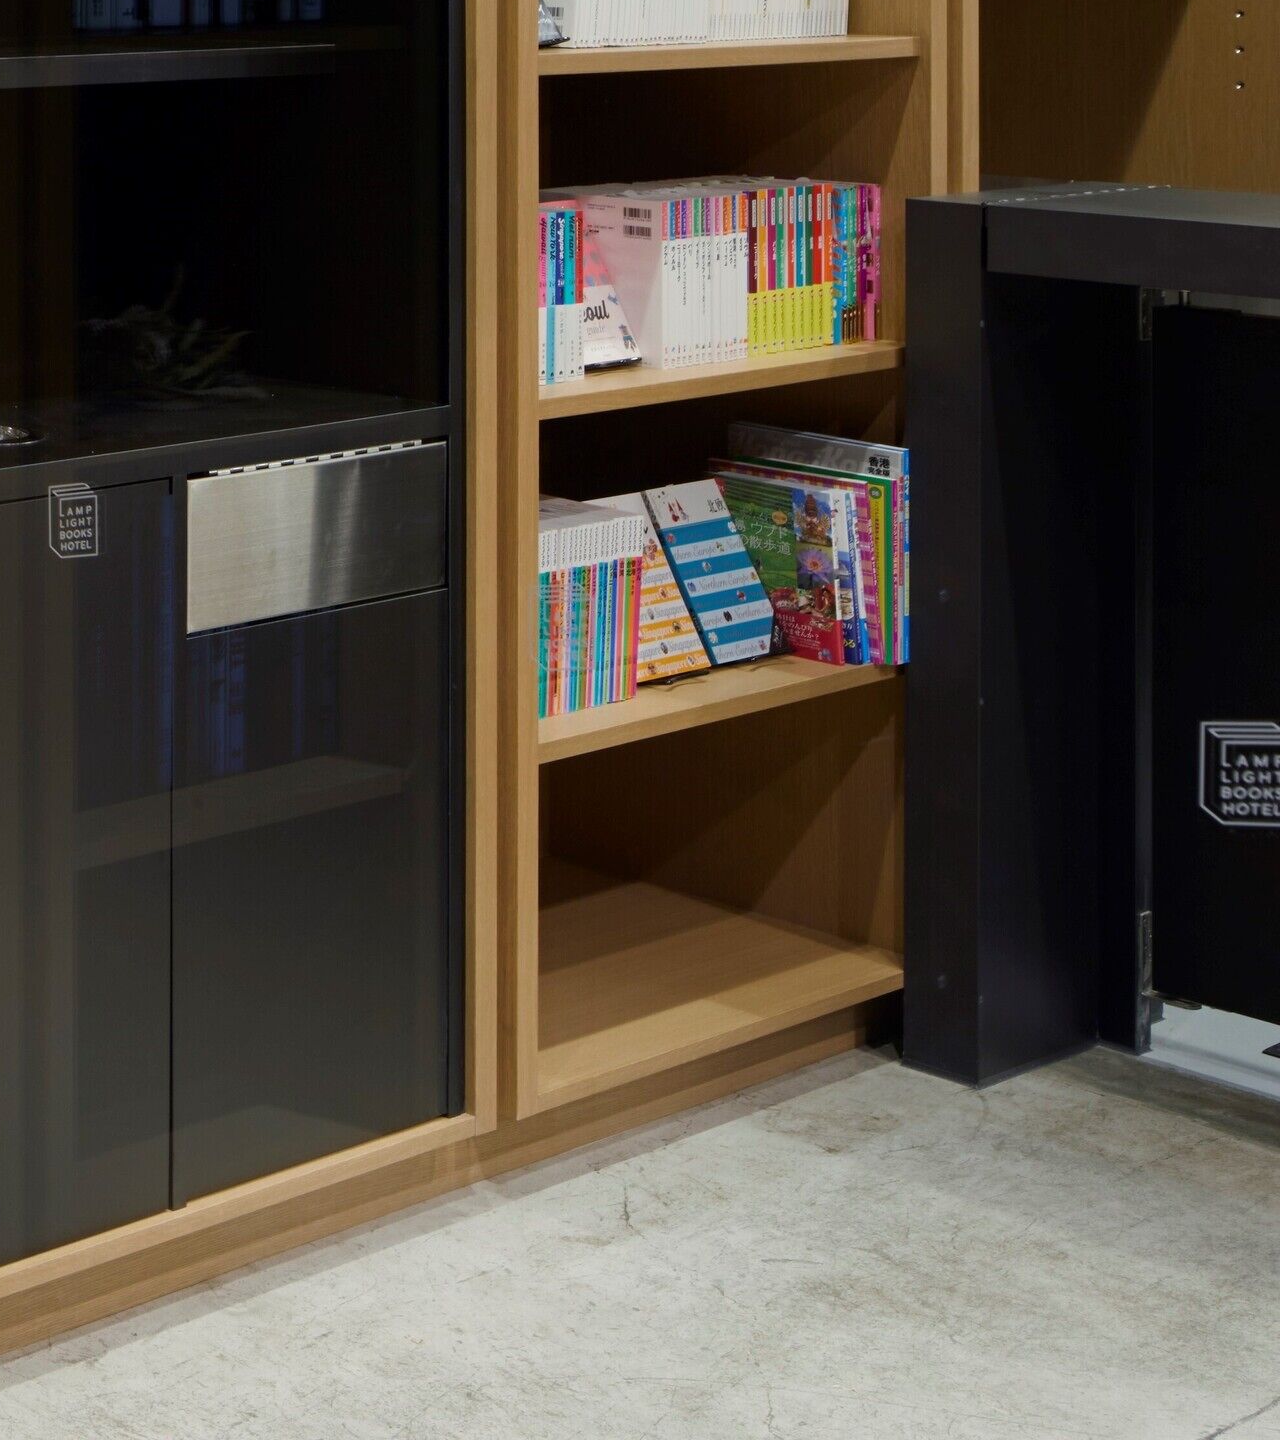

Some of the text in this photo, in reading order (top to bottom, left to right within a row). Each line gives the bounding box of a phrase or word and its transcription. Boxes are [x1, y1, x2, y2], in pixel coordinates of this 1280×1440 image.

[59, 505, 92, 517] LAMP
[59, 516, 92, 529] LIGHT
[59, 528, 92, 540] BOOKS
[60, 540, 92, 551] HOTEL
[1220, 801, 1280, 817] HOTEL
